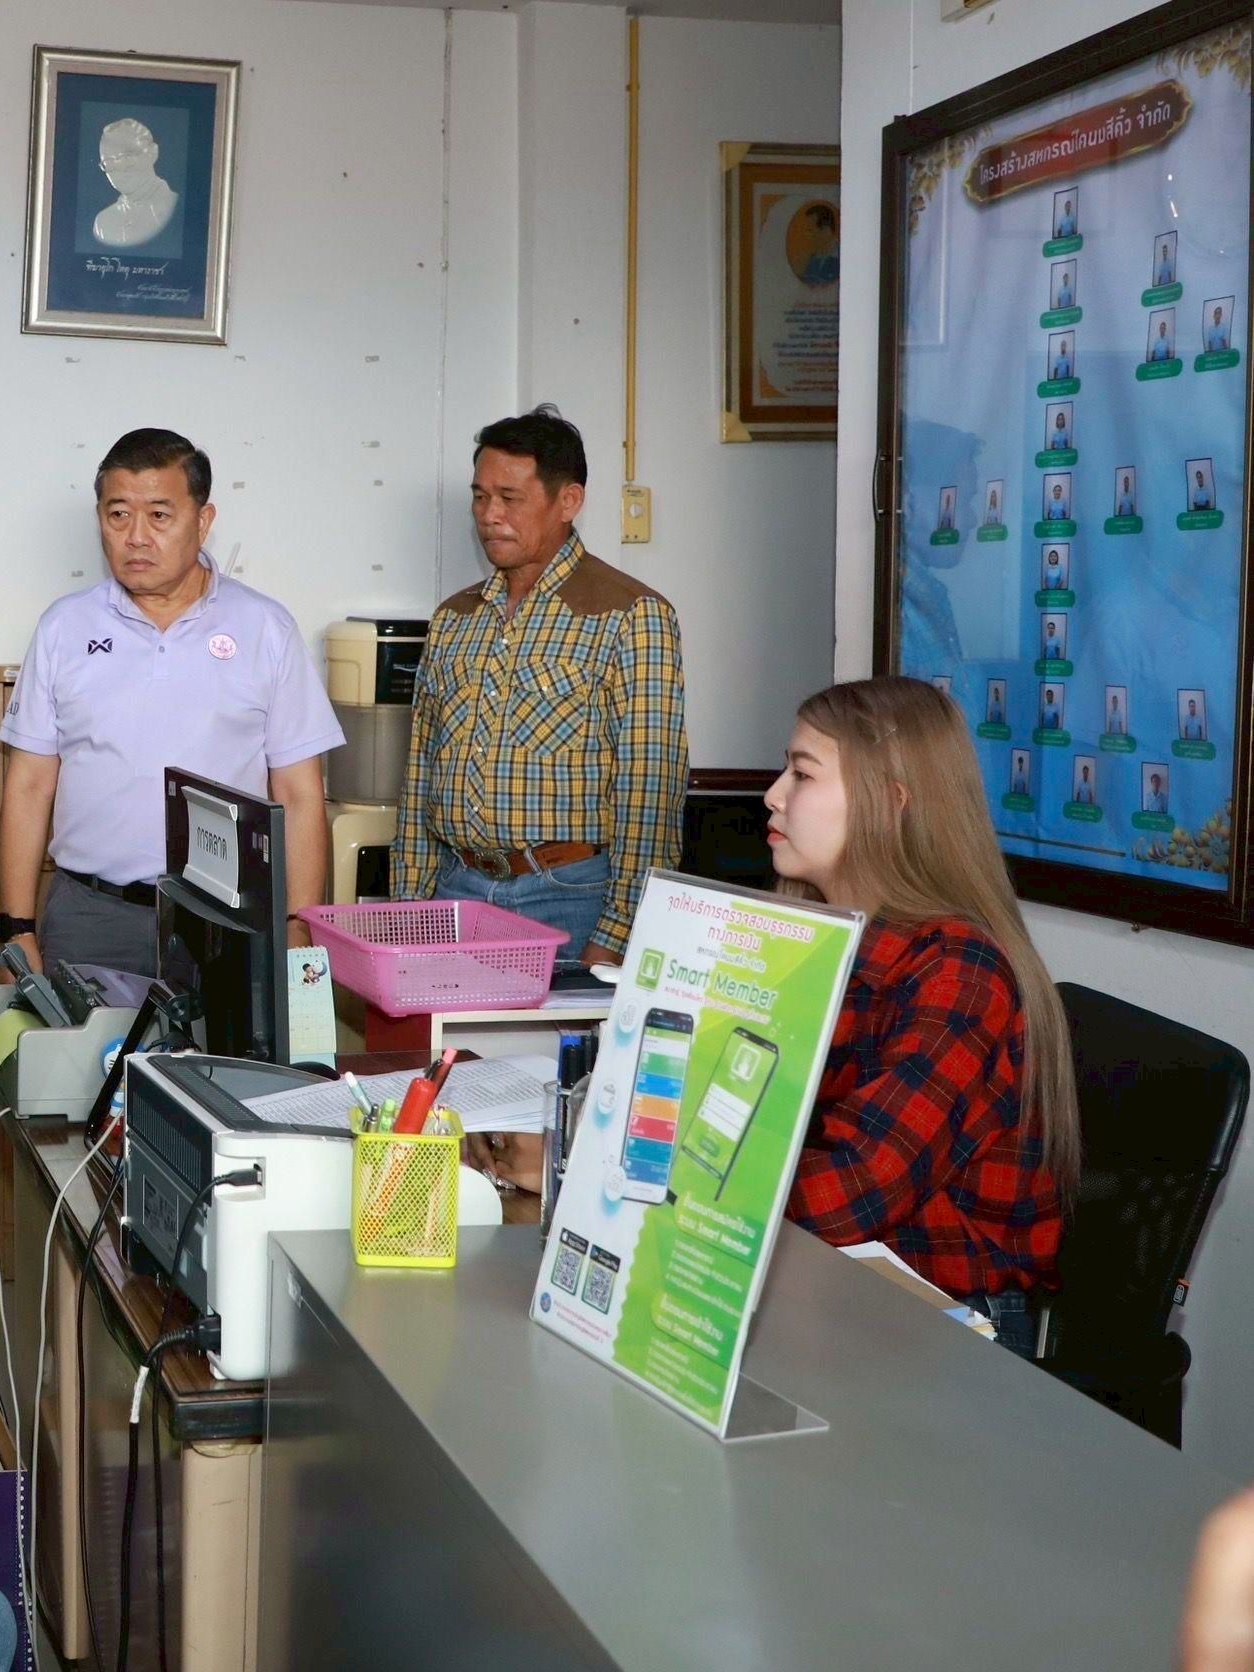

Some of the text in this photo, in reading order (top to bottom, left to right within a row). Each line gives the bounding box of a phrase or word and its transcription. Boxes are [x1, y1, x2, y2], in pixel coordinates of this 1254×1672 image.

[1136, 100, 1171, 130] จำกัด
[666, 958, 711, 989] Smart
[713, 971, 777, 1008] Member
